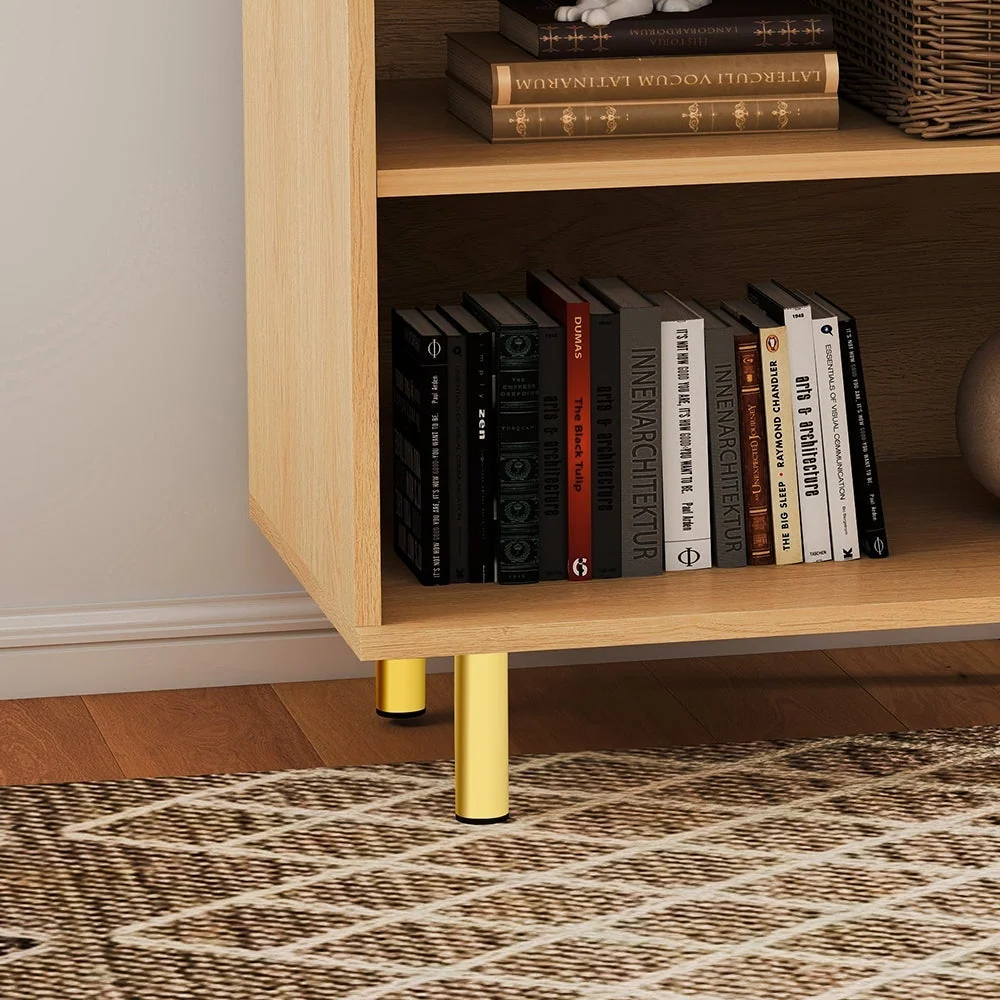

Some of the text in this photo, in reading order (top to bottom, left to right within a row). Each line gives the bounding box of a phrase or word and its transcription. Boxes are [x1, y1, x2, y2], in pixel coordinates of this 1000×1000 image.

[629, 26, 738, 36] LANGOBARDORUM
[650, 37, 708, 47] HISTORIA
[515, 70, 822, 90] LATERCULI VOCUM LATINARUM
[574, 316, 584, 360] DUMAS
[676, 328, 688, 340] IT'S
[676, 340, 688, 351] NOT
[677, 353, 689, 365] HOW
[678, 381, 690, 392] YOU
[795, 375, 812, 401] arts
[677, 394, 691, 406] ARE,
[678, 407, 691, 418] IT'S
[747, 405, 761, 440] JOURNEY
[825, 344, 846, 500] ESSENTIALS OF VISUAL COMMUNICATION
[478, 408, 486, 440] zen
[679, 419, 691, 431] HOW
[573, 397, 584, 492] The Black Tulip
[631, 348, 658, 560] INNENARCHITEKTUR
[714, 364, 743, 553] INNENARCHITEKTUR
[769, 360, 791, 551] THE BIG SLEEP RAYMOND CHANDLER
[799, 421, 819, 497] architecture
[680, 459, 692, 475] WANT
[681, 476, 693, 484] TO
[682, 502, 694, 531] Paul Arden
